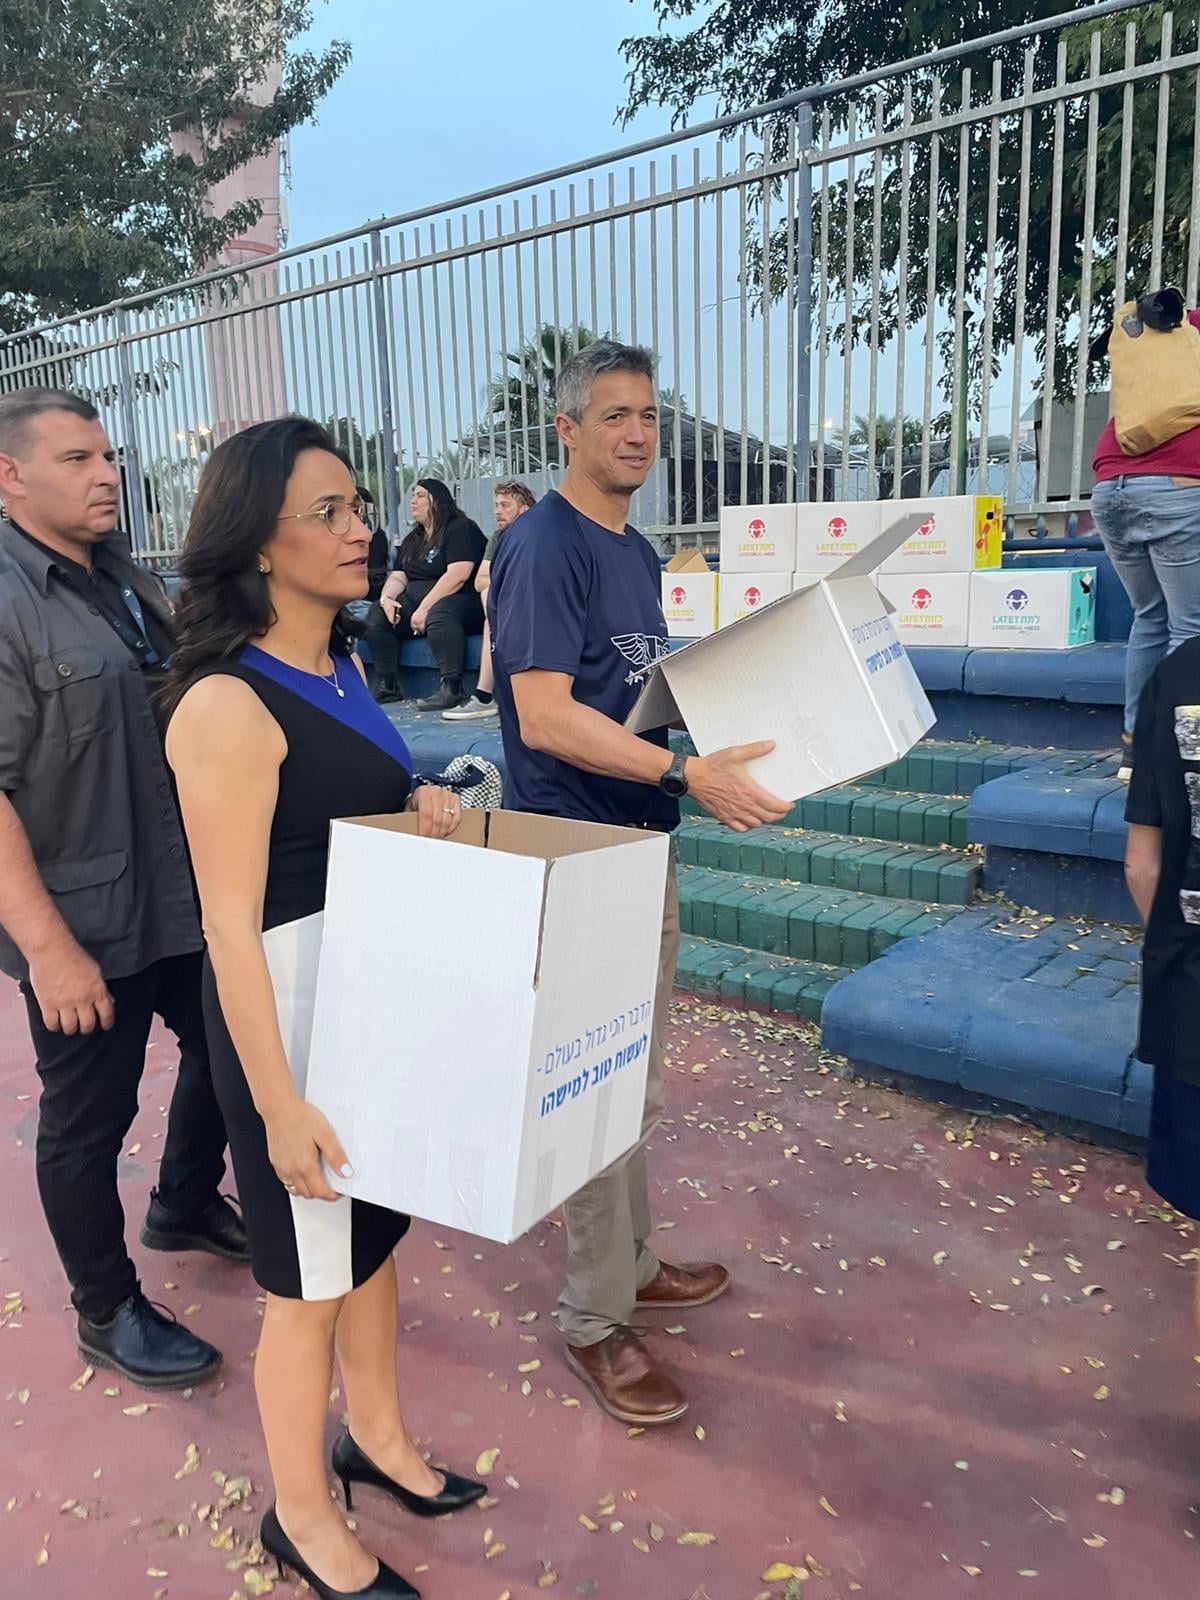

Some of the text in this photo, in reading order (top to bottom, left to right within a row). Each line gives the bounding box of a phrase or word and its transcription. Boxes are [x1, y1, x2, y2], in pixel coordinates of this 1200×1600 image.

[609, 1015, 625, 1038] הכי
[628, 1000, 651, 1026] הדבר
[585, 1025, 607, 1053] גדול
[545, 1038, 582, 1075] בעולם
[540, 1032, 648, 1117] לעשות טוב למישהו
